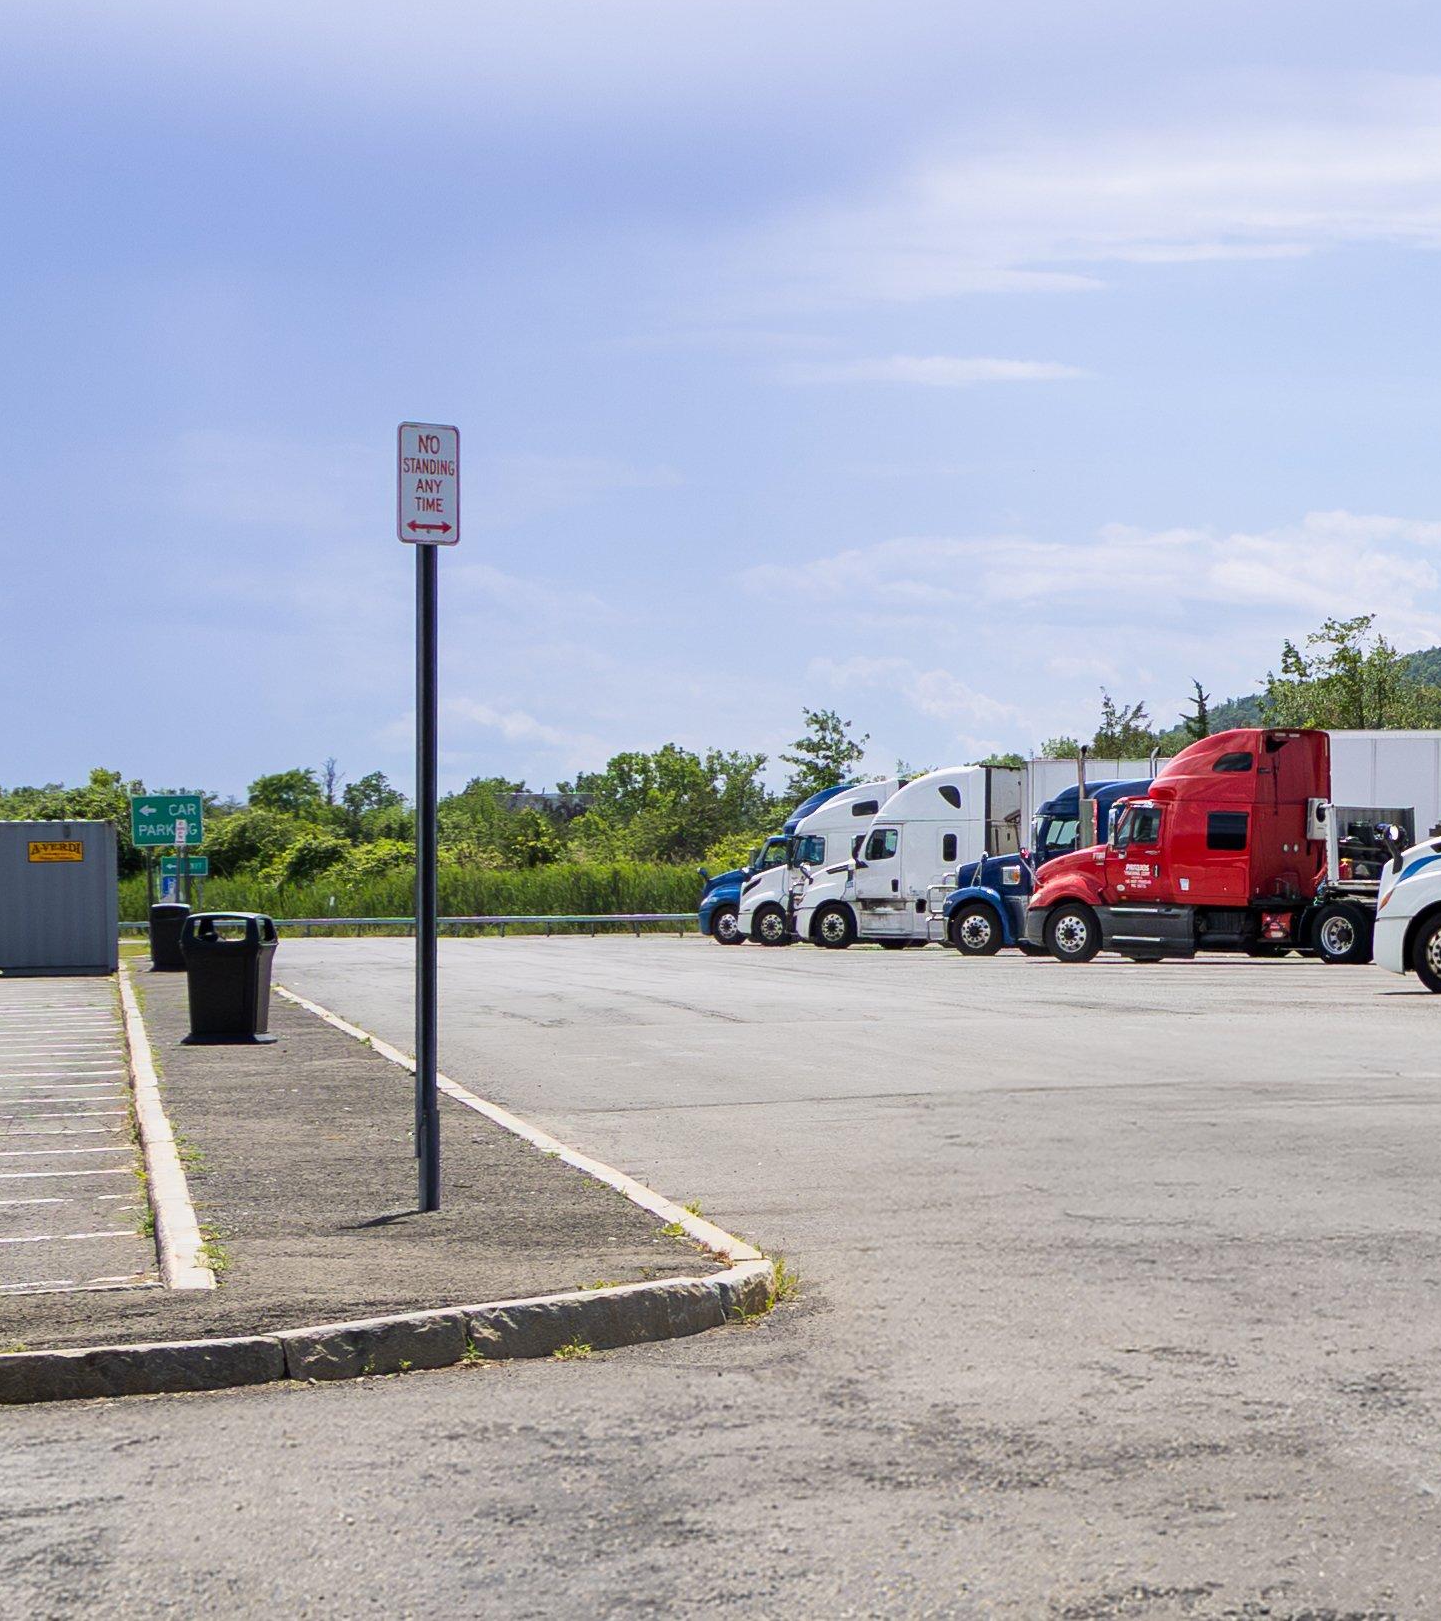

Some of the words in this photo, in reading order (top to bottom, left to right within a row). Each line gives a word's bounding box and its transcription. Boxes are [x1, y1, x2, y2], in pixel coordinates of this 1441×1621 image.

[418, 434, 440, 454] NO
[403, 457, 455, 476] STANDING
[416, 479, 443, 494] ANY
[414, 497, 443, 513] TIME
[168, 803, 196, 816] CAR
[138, 823, 198, 836] PARKG
